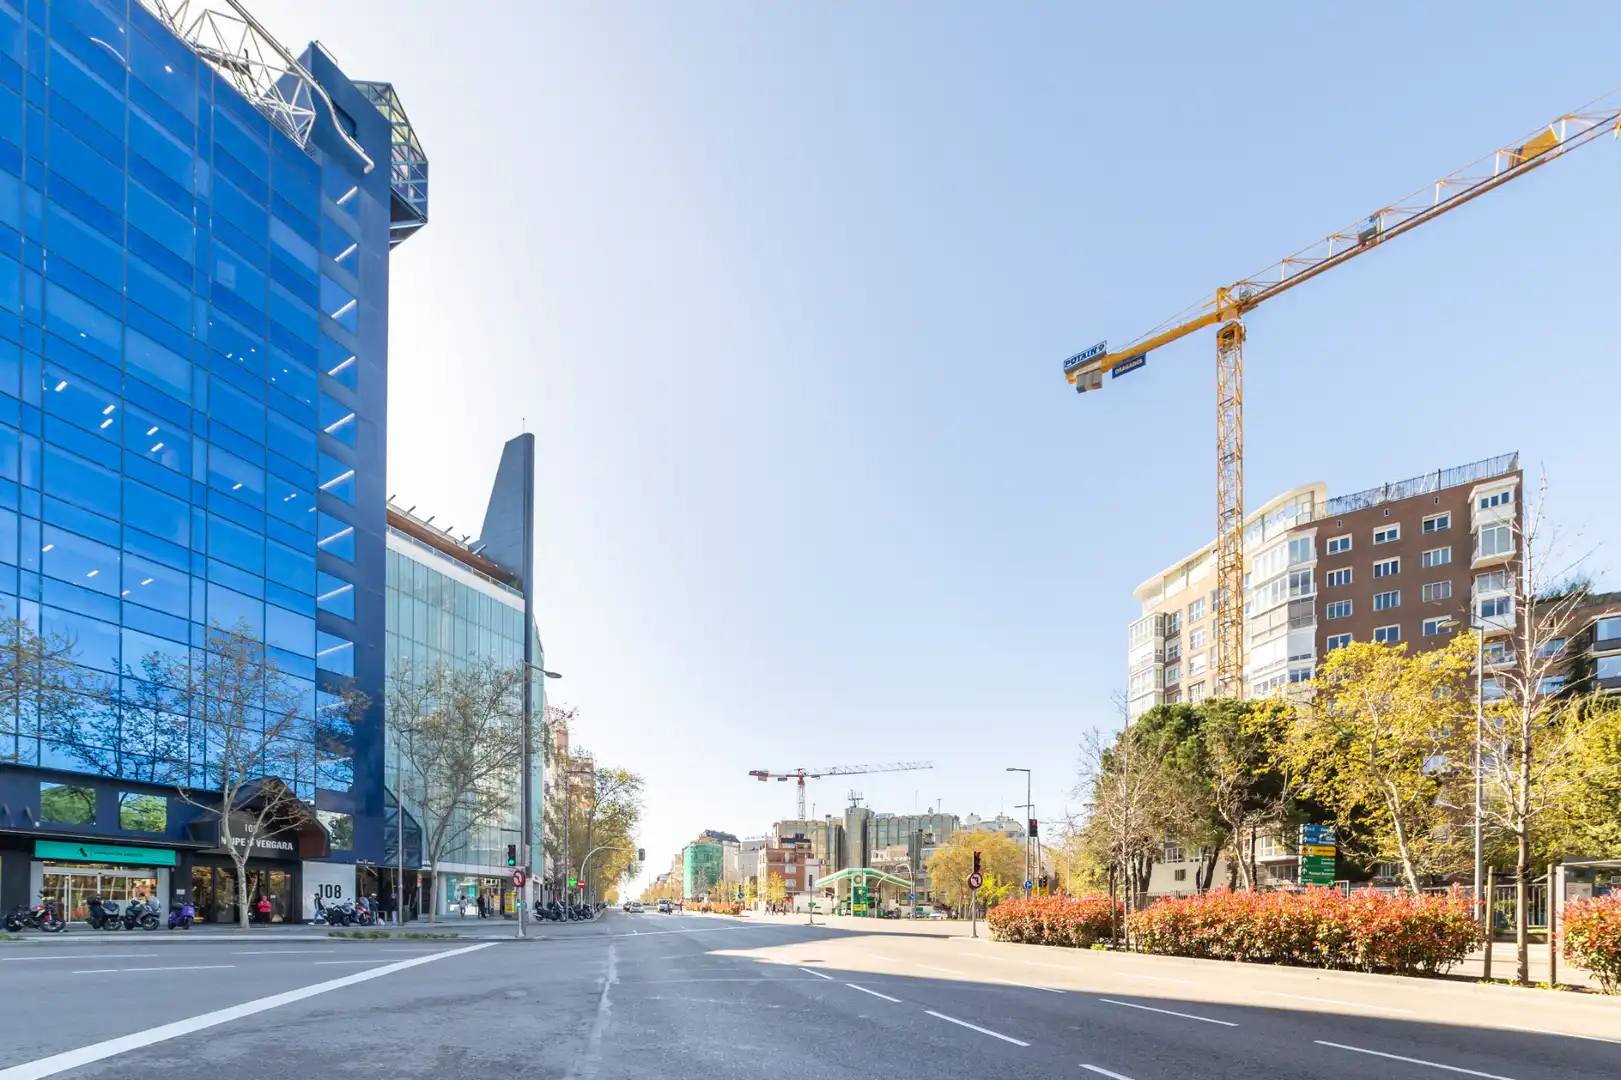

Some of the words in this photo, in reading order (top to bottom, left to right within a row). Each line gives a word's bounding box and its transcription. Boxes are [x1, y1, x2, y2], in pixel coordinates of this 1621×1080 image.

[1065, 345, 1097, 367] POTAIN
[256, 839, 293, 851] VERGARA
[318, 883, 342, 899] 108
